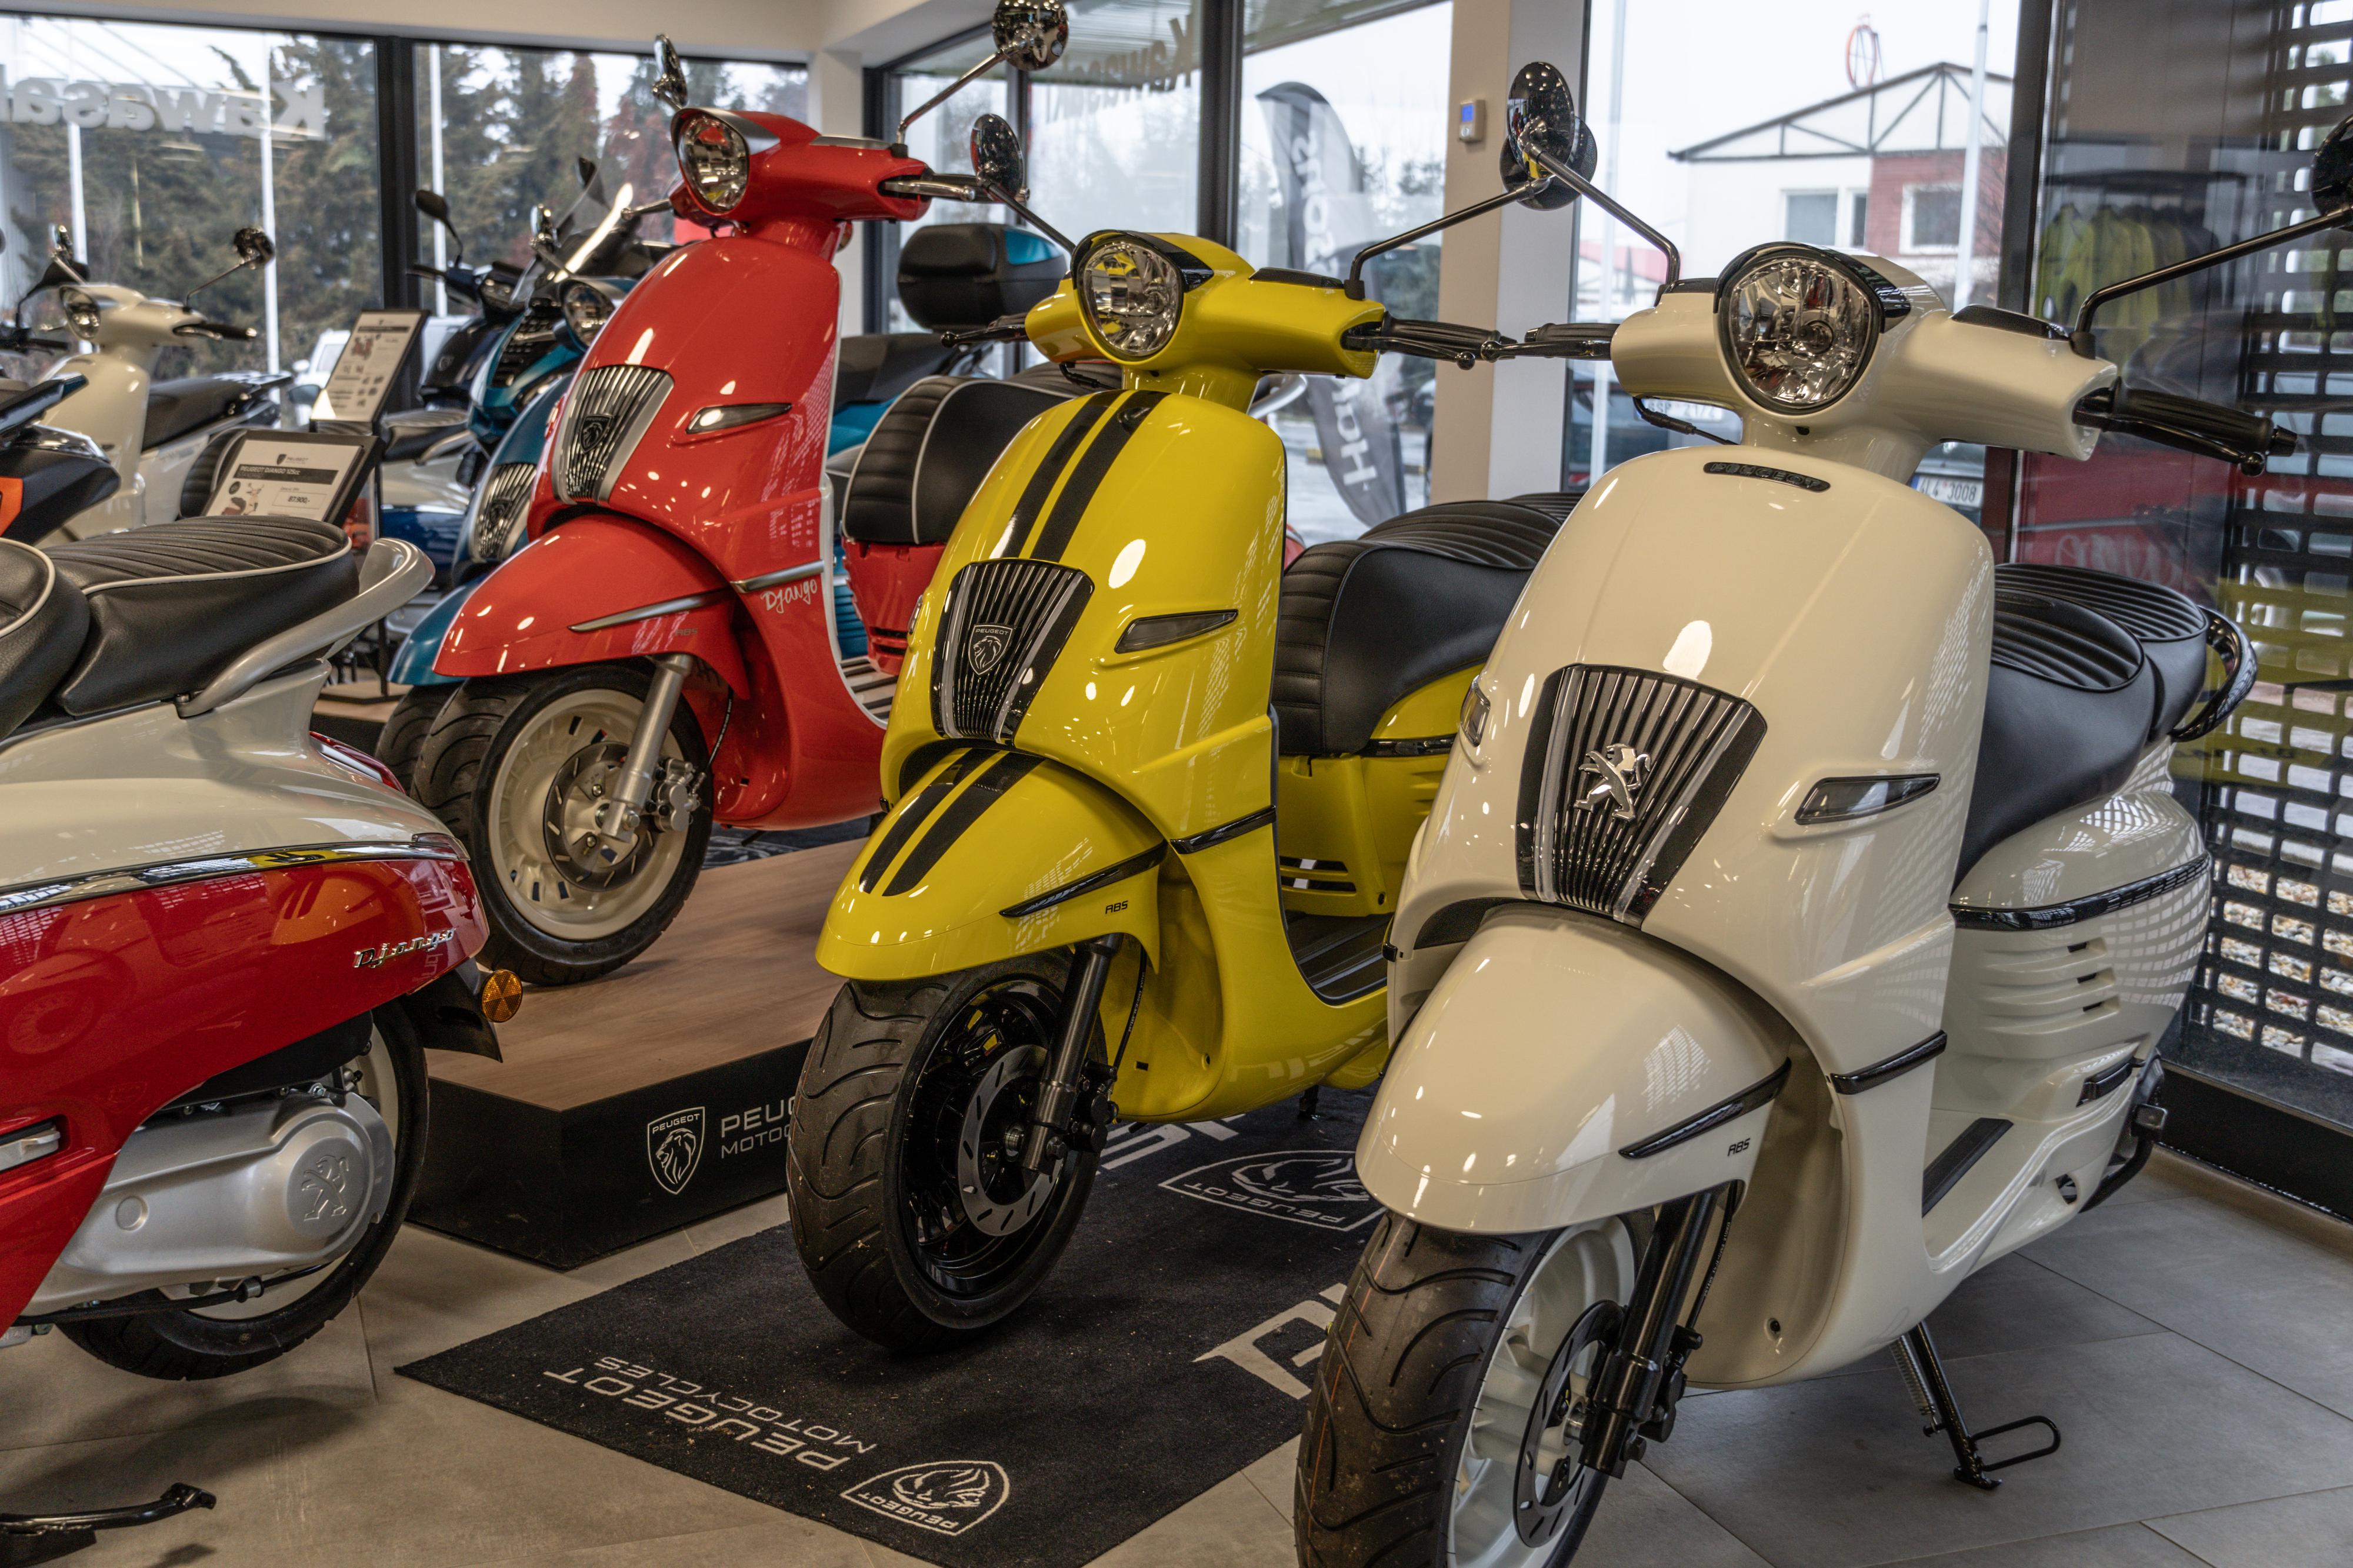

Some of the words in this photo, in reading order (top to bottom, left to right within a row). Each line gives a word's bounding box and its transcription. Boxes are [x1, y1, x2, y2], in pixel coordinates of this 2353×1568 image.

[1709, 462, 1821, 488] PEUGEOT
[1947, 482, 1977, 502] 3008
[1105, 900, 1128, 914] ABS
[354, 928, 456, 969] Django
[652, 1113, 700, 1135] PEUGEOT
[1727, 1137, 1751, 1157] ABS
[1184, 1182, 1348, 1224] PEUGEOT
[543, 1367, 851, 1471] PEUGEOT
[594, 1356, 878, 1454] MOTOCYCLES
[859, 1491, 960, 1529] PEUGEOT
